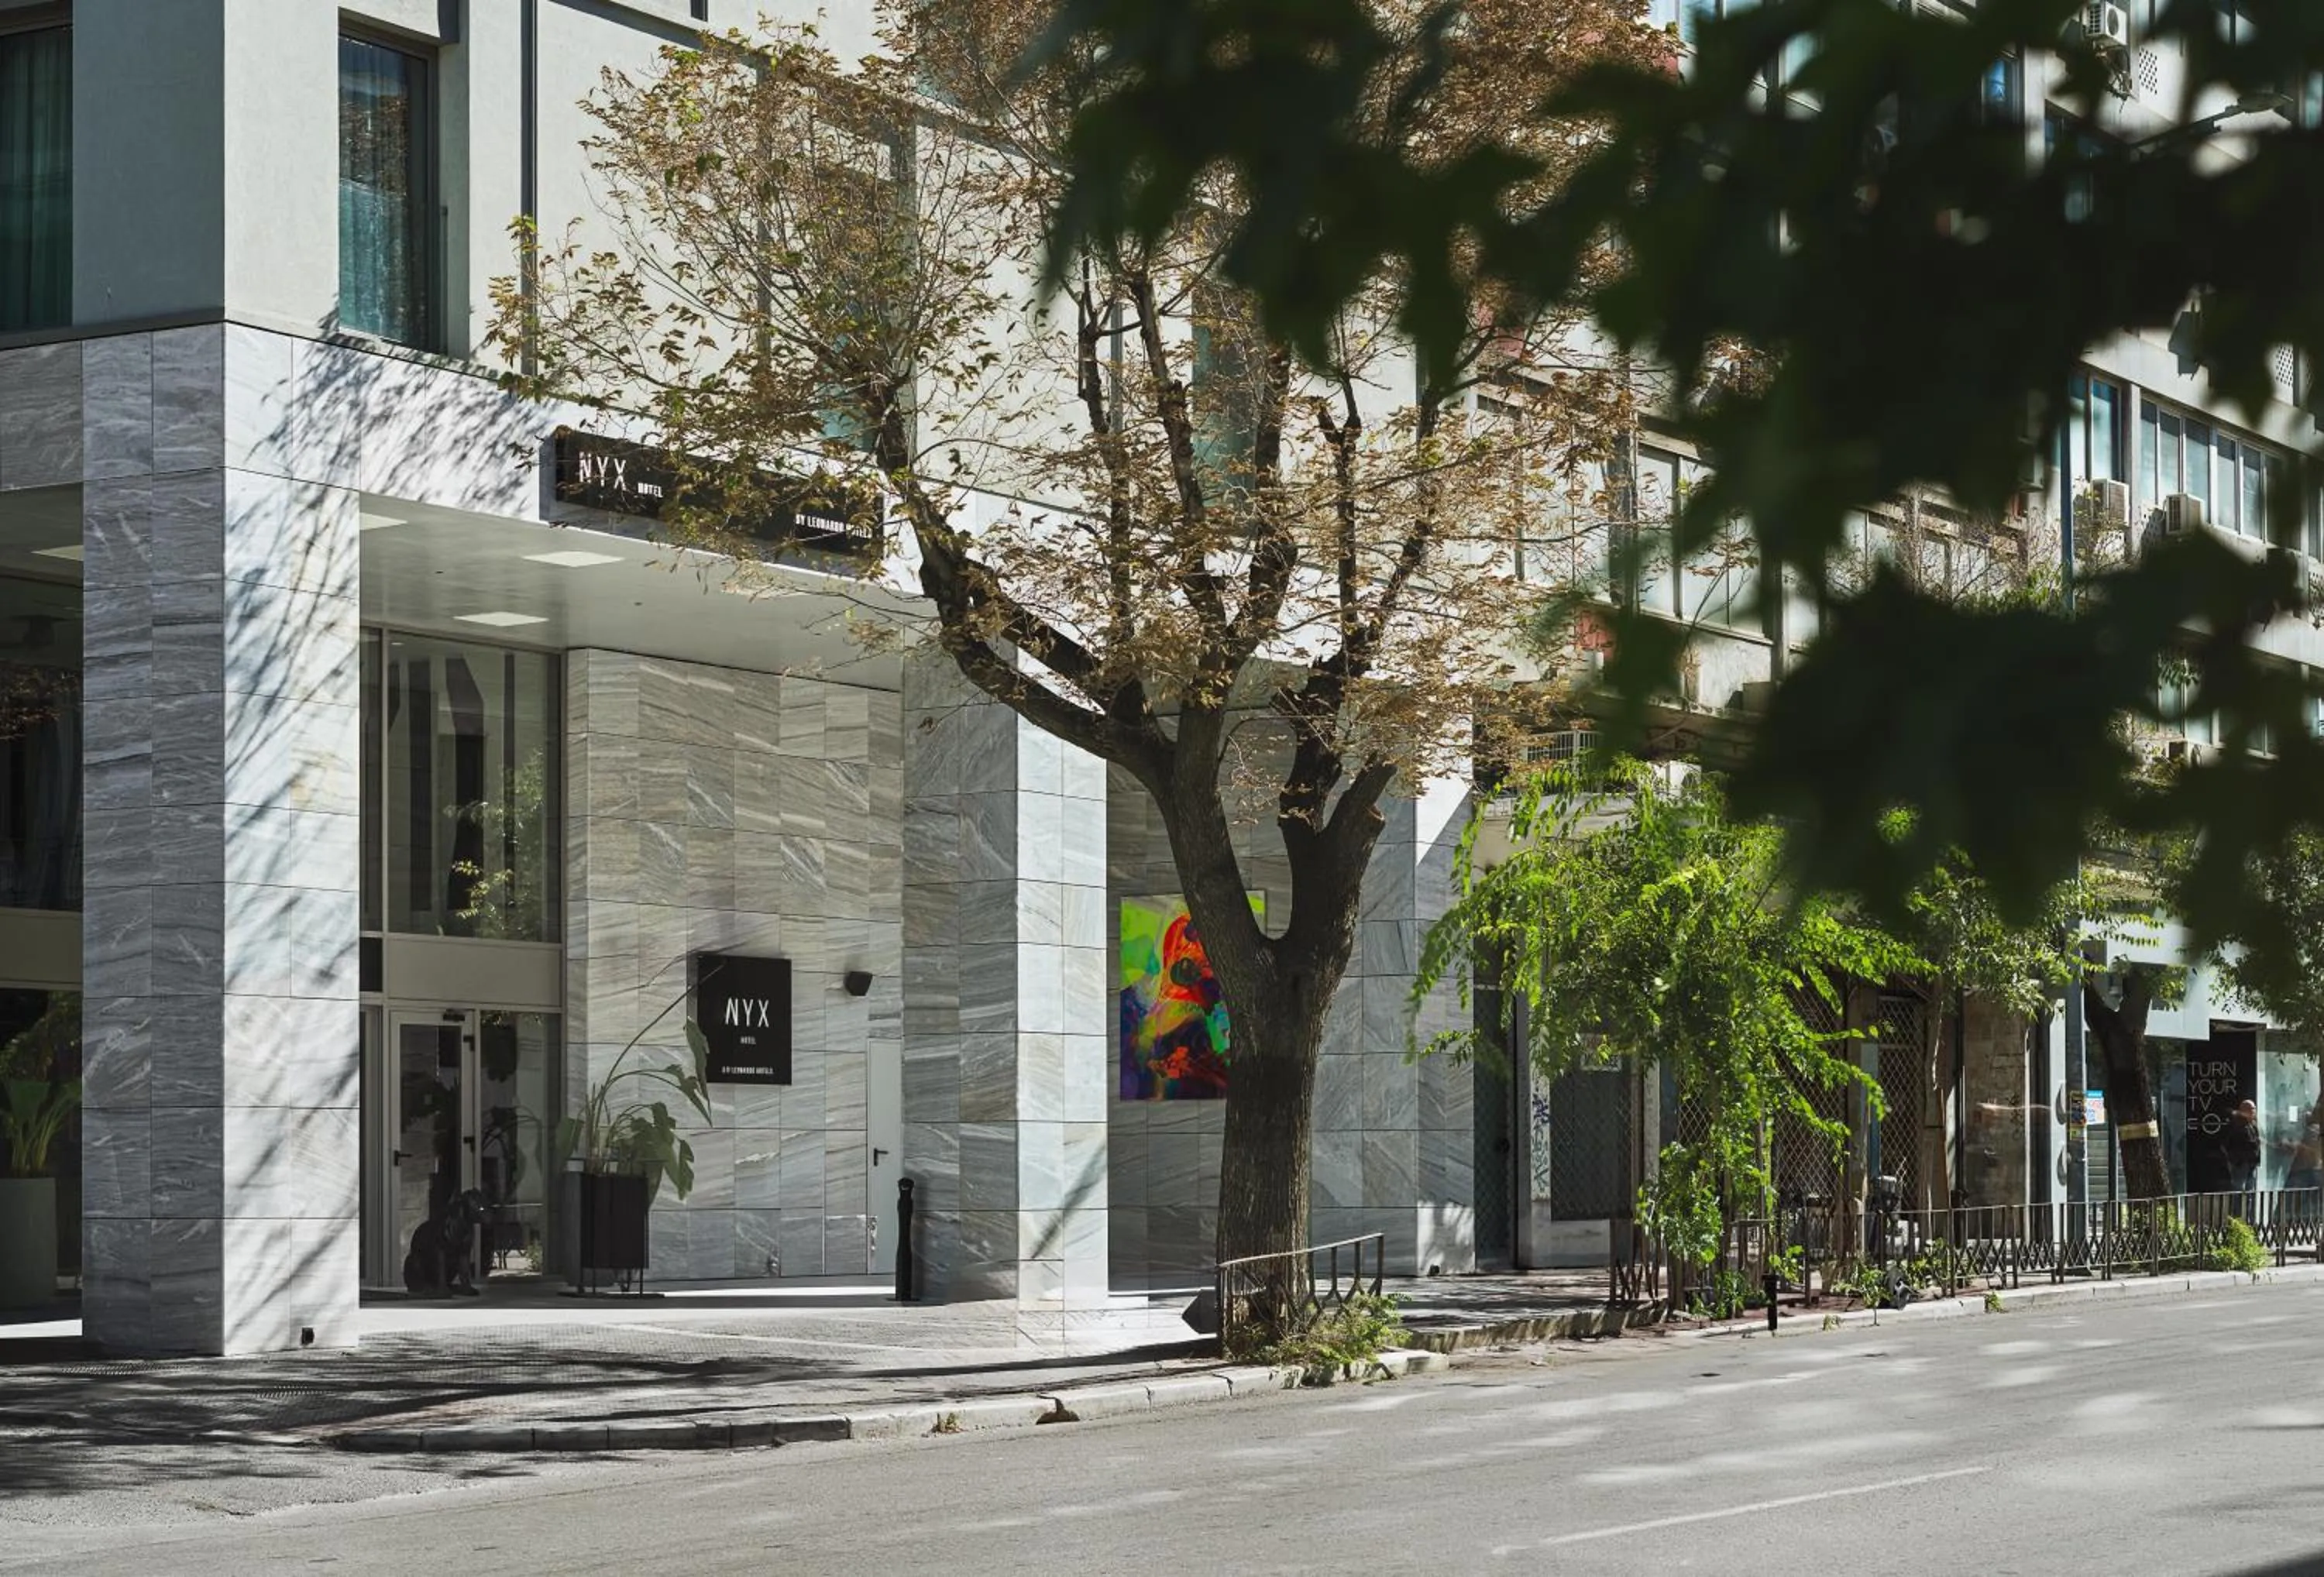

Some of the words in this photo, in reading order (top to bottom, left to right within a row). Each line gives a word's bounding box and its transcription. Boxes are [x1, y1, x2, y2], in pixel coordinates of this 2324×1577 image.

[579, 452, 627, 490] NYX
[638, 482, 664, 498] HOTEL
[725, 997, 769, 1028] NYX
[2188, 1061, 2236, 1077] TURN
[2188, 1079, 2236, 1094] YOUR
[2188, 1096, 2212, 1111] TV
